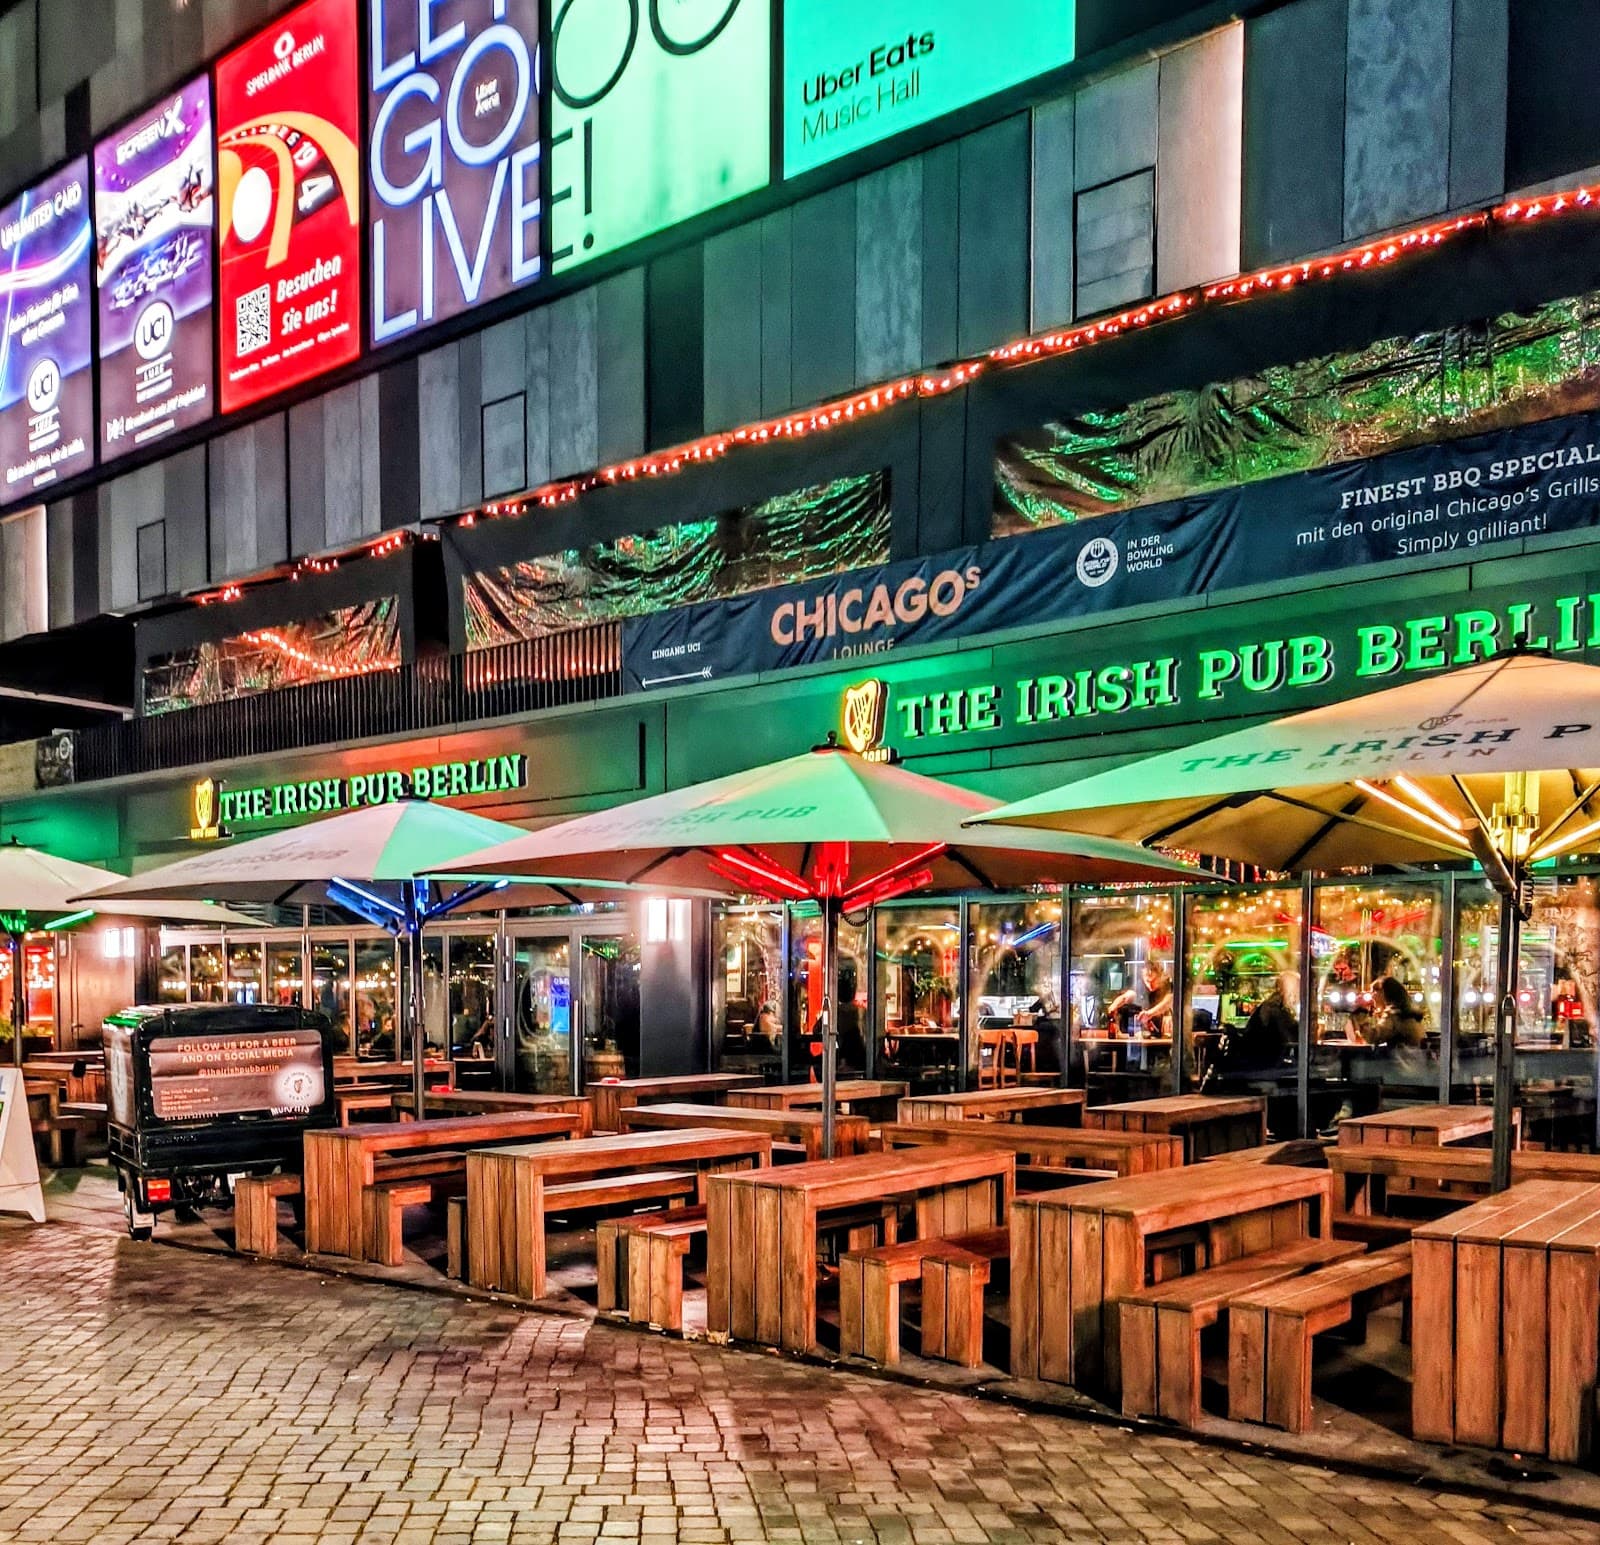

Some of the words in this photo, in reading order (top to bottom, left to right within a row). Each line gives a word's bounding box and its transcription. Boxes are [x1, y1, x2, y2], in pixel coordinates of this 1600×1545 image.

[246, 57, 293, 97] SPIELBANK
[292, 34, 326, 70] BERLIN
[372, 0, 507, 92] LE
[803, 59, 864, 106] Uber
[870, 30, 935, 78] Eats
[803, 94, 872, 145] Music
[877, 67, 920, 113] Hall
[54, 180, 83, 217] CARD
[276, 255, 343, 303] Besuchen
[143, 315, 165, 346] UCI
[280, 307, 303, 336] Sie
[304, 289, 338, 325] uns!
[34, 371, 53, 400] UCI
[1340, 476, 1426, 510] FINEST
[1433, 466, 1481, 493] BBQ
[1489, 443, 1600, 482] SPECIAL
[1296, 525, 1325, 546] mit
[1331, 519, 1364, 540] den
[1371, 504, 1440, 531] original
[1447, 486, 1539, 517] Chicago's
[1548, 476, 1599, 499] Grills
[1127, 540, 1138, 550] IN
[1140, 535, 1161, 546] DER
[1127, 544, 1174, 562] BOWLING
[1397, 530, 1460, 555] Simply
[1467, 513, 1548, 547] grilliant!
[1126, 558, 1162, 573] WORLD
[652, 644, 686, 660] EINGANG
[687, 641, 701, 653] UCI
[833, 638, 895, 660] LOUNGE
[896, 685, 1001, 738] THE
[1016, 657, 1180, 724] IRISH
[1198, 634, 1332, 699] PUB
[1179, 748, 1303, 773] THE
[1318, 728, 1521, 758] IRISH
[220, 790, 266, 822] THE
[272, 778, 344, 815] IRISH
[350, 771, 404, 806] PUB
[413, 754, 524, 799] BERLIN
[177, 1042, 220, 1053] FOLLOW
[223, 1041, 237, 1050] US
[239, 1039, 259, 1049] FOR
[262, 1039, 269, 1047] A
[272, 1037, 297, 1047] BEER
[182, 1054, 203, 1064] AND
[206, 1053, 221, 1062] ON
[224, 1049, 261, 1061] SOCIAL
[263, 1048, 294, 1059] MEDIA
